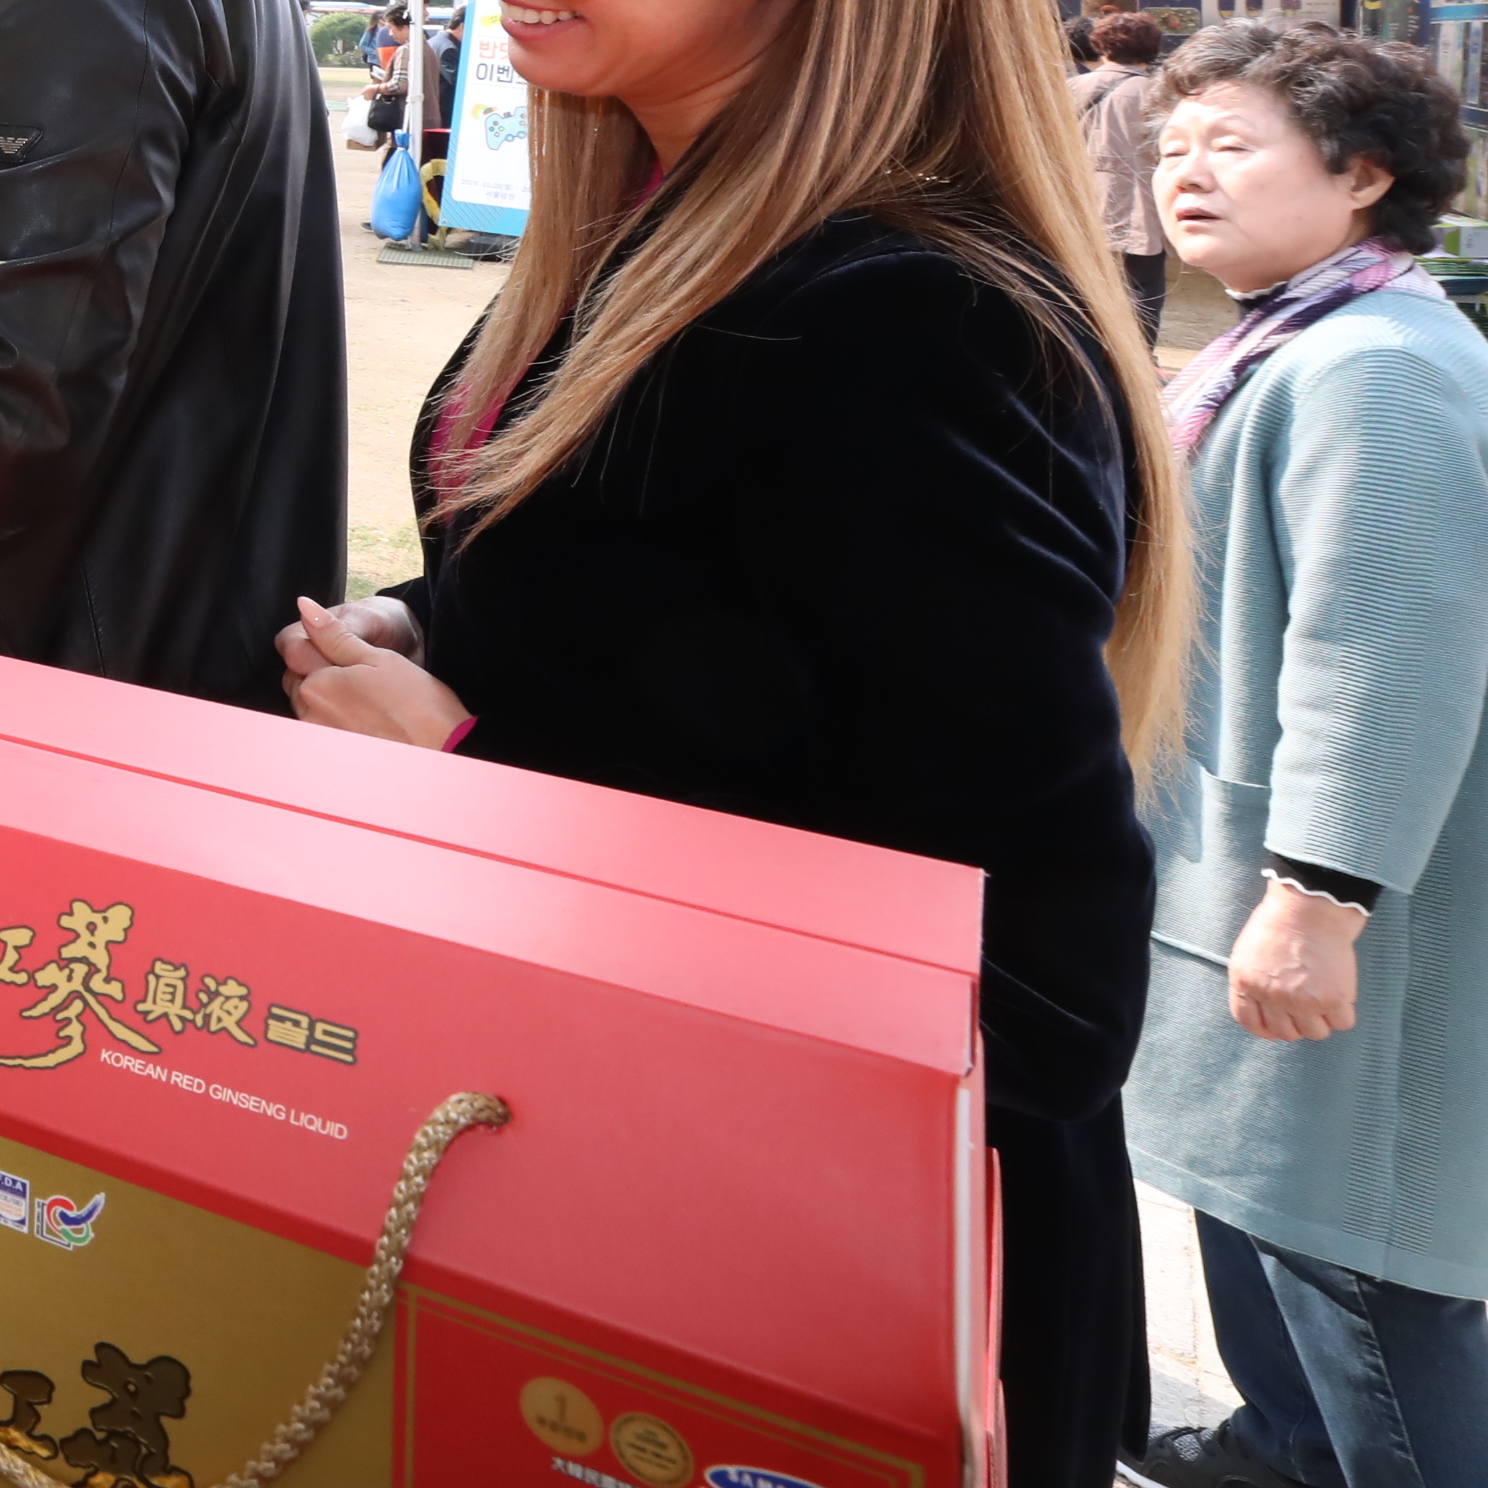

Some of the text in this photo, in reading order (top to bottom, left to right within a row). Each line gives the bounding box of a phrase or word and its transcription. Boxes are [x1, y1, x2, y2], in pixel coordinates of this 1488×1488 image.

[265, 1004, 358, 1066] 골드
[100, 1049, 349, 1141] KOREAN RED GINSENG LIQUID
